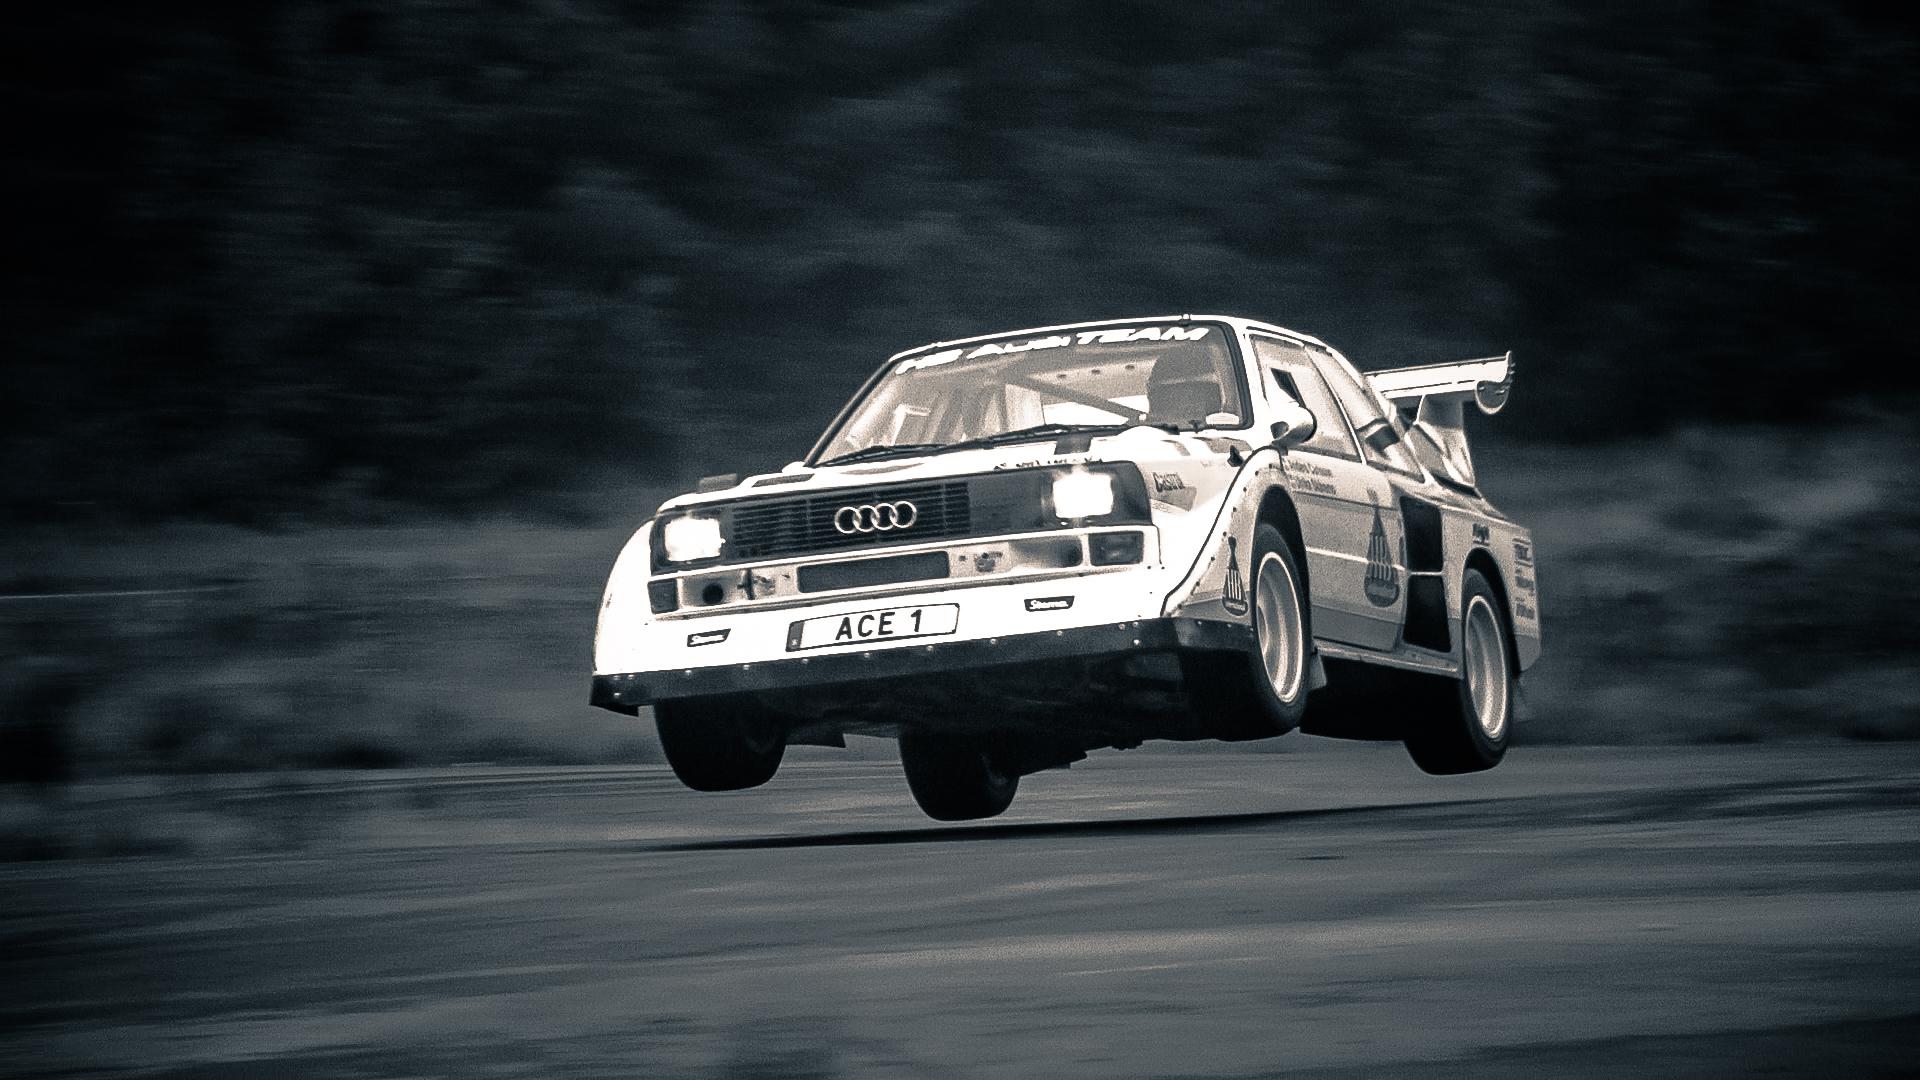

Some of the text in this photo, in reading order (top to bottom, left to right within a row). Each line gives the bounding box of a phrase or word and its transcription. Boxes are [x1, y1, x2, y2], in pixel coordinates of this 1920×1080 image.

[1076, 326, 1210, 345] TEAM
[835, 608, 922, 641] ACE 1
